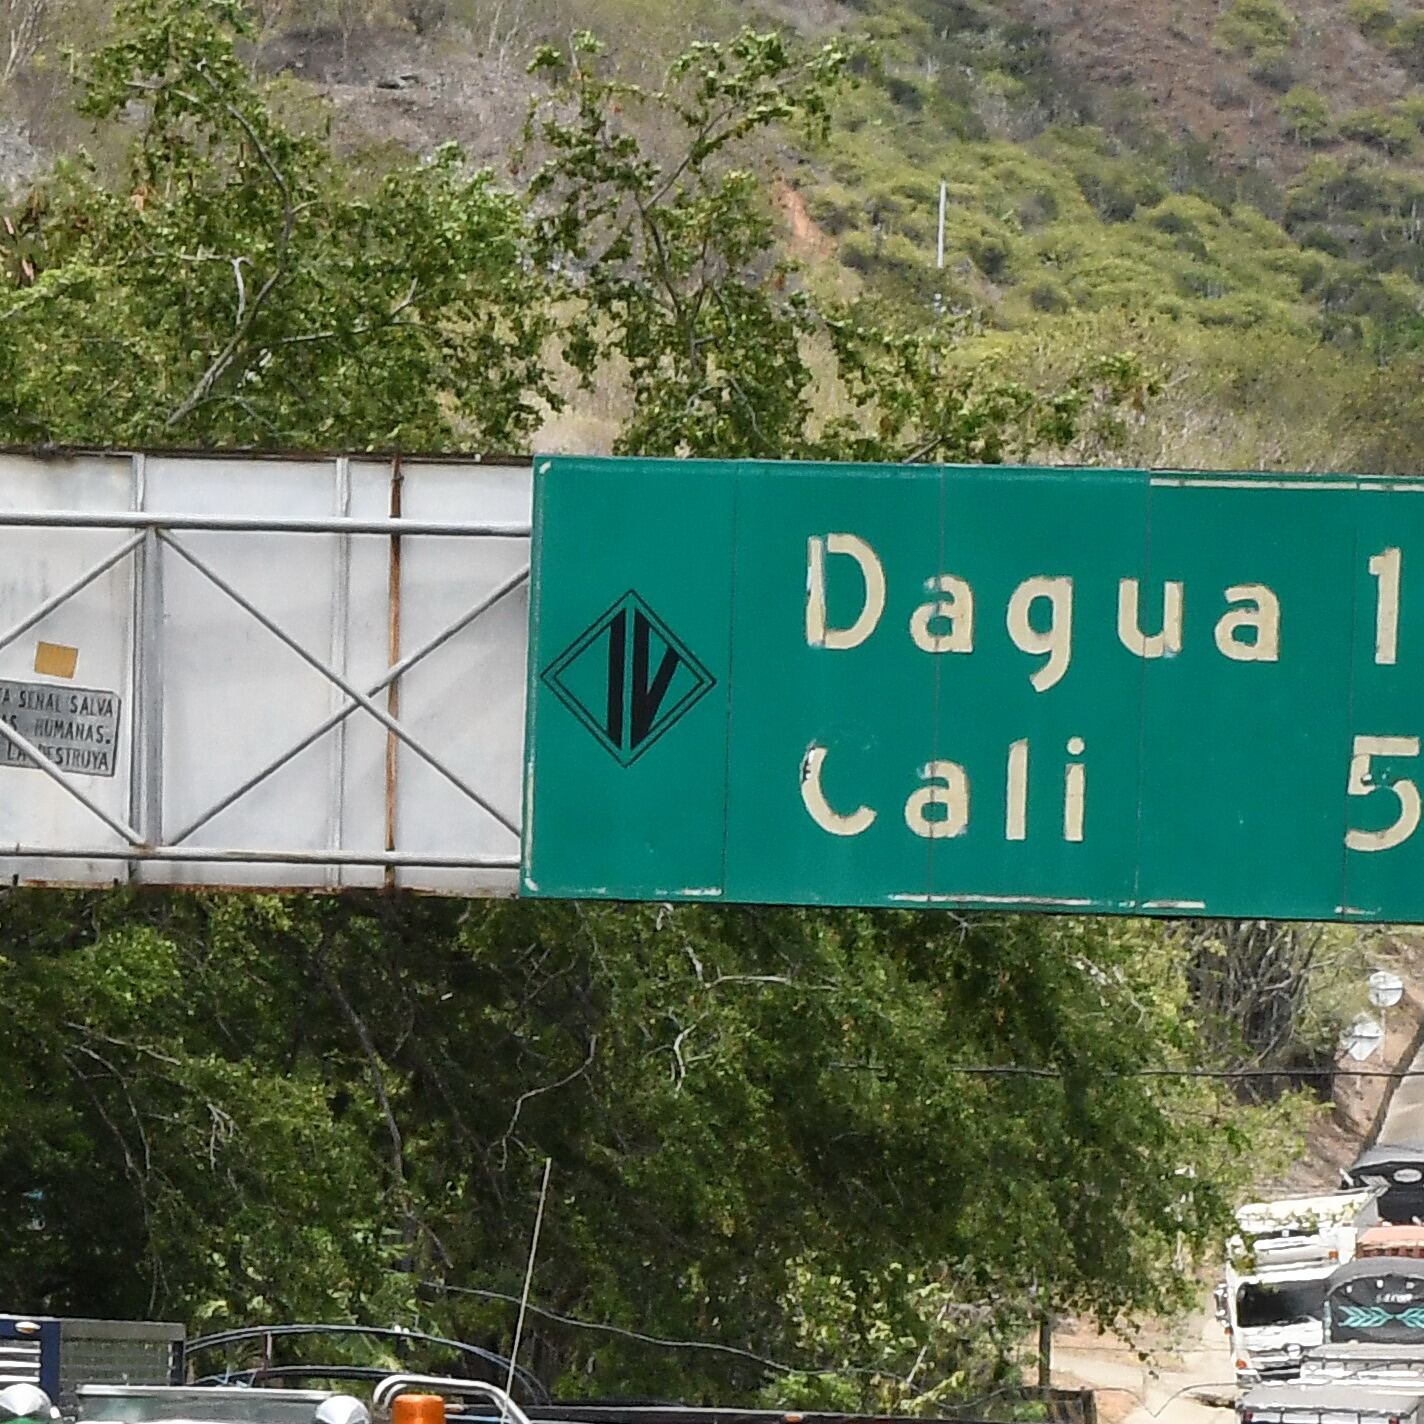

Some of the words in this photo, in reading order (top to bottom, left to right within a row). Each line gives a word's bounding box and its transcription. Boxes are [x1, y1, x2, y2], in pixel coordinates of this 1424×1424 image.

[806, 533, 1280, 692] Dagua
[69, 695, 113, 717] SALVA
[800, 737, 1085, 842] Cali
